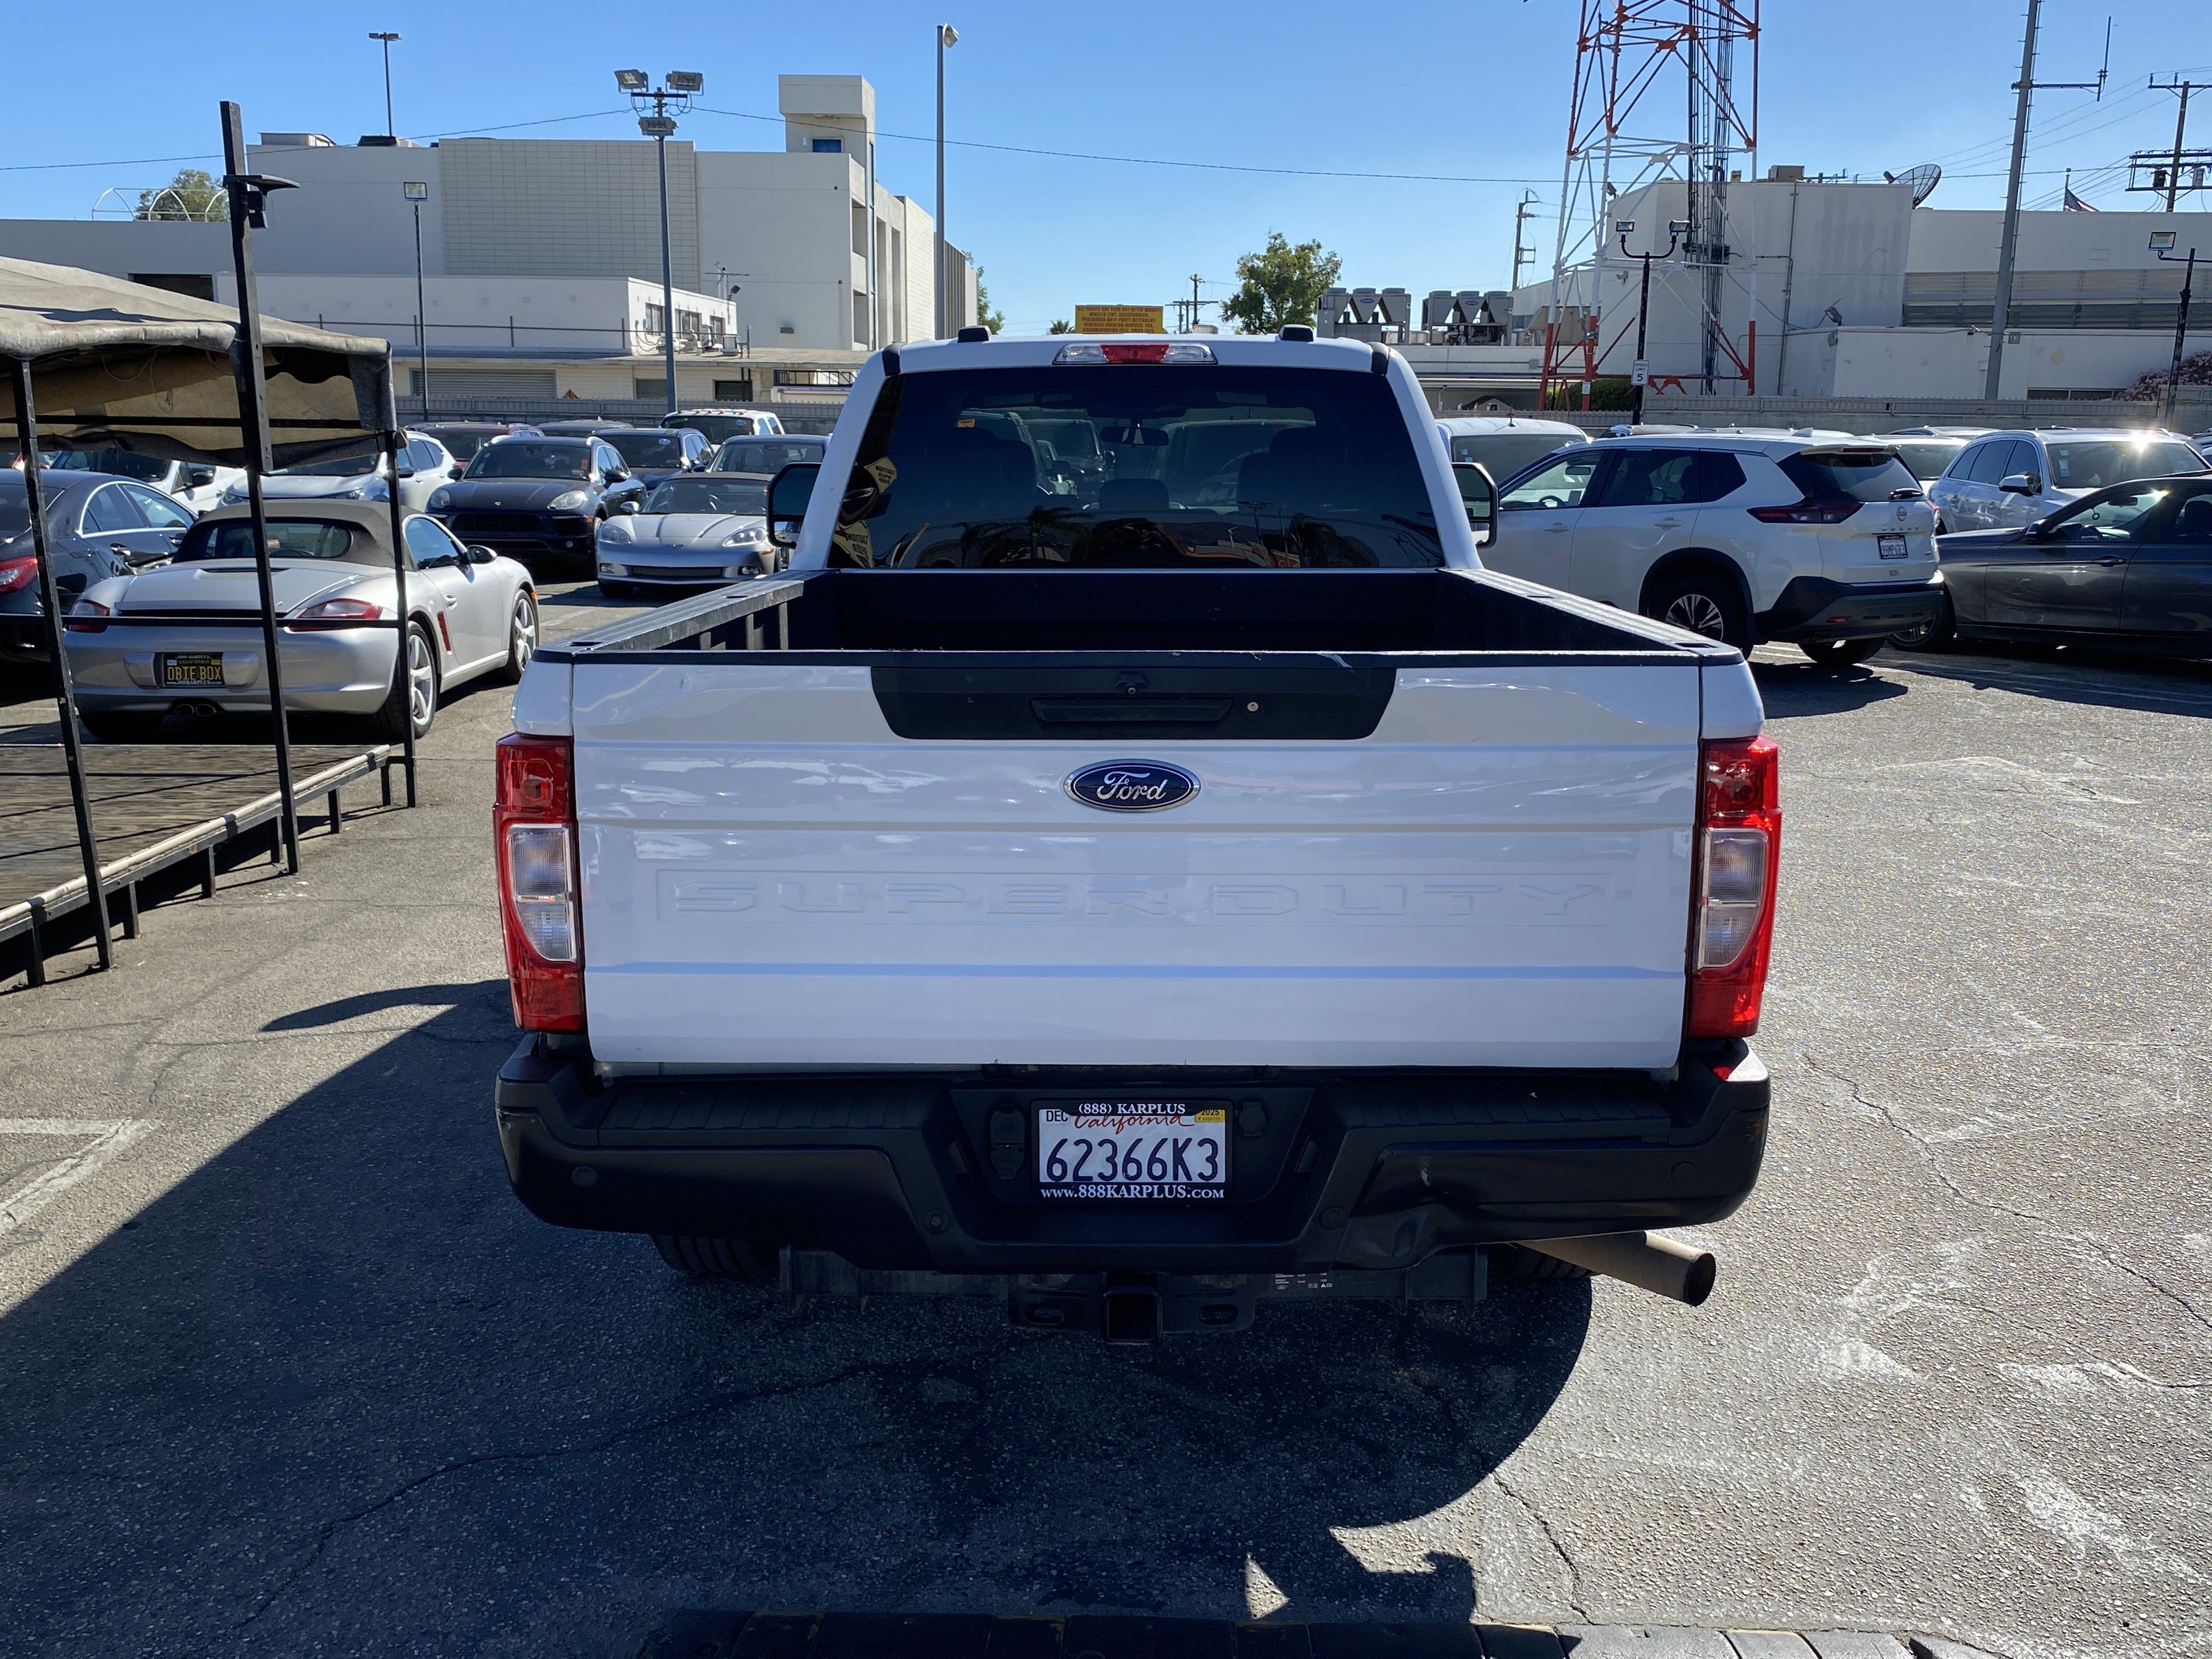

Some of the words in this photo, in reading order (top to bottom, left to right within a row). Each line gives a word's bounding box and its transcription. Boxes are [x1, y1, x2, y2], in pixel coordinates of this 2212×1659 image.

[1637, 374, 1643, 382] 5
[167, 666, 196, 680] OBIE
[199, 666, 222, 680] BOX
[1097, 771, 1168, 800] Ford
[673, 881, 1170, 917] SUPER
[1209, 883, 1605, 917] DUTY
[1079, 1103, 1112, 1114] (888)
[1117, 1103, 1186, 1114] KARPLUS
[1046, 1110, 1068, 1122] DEC
[1074, 1115, 1195, 1135] California
[1046, 1137, 1218, 1182] 62366K3
